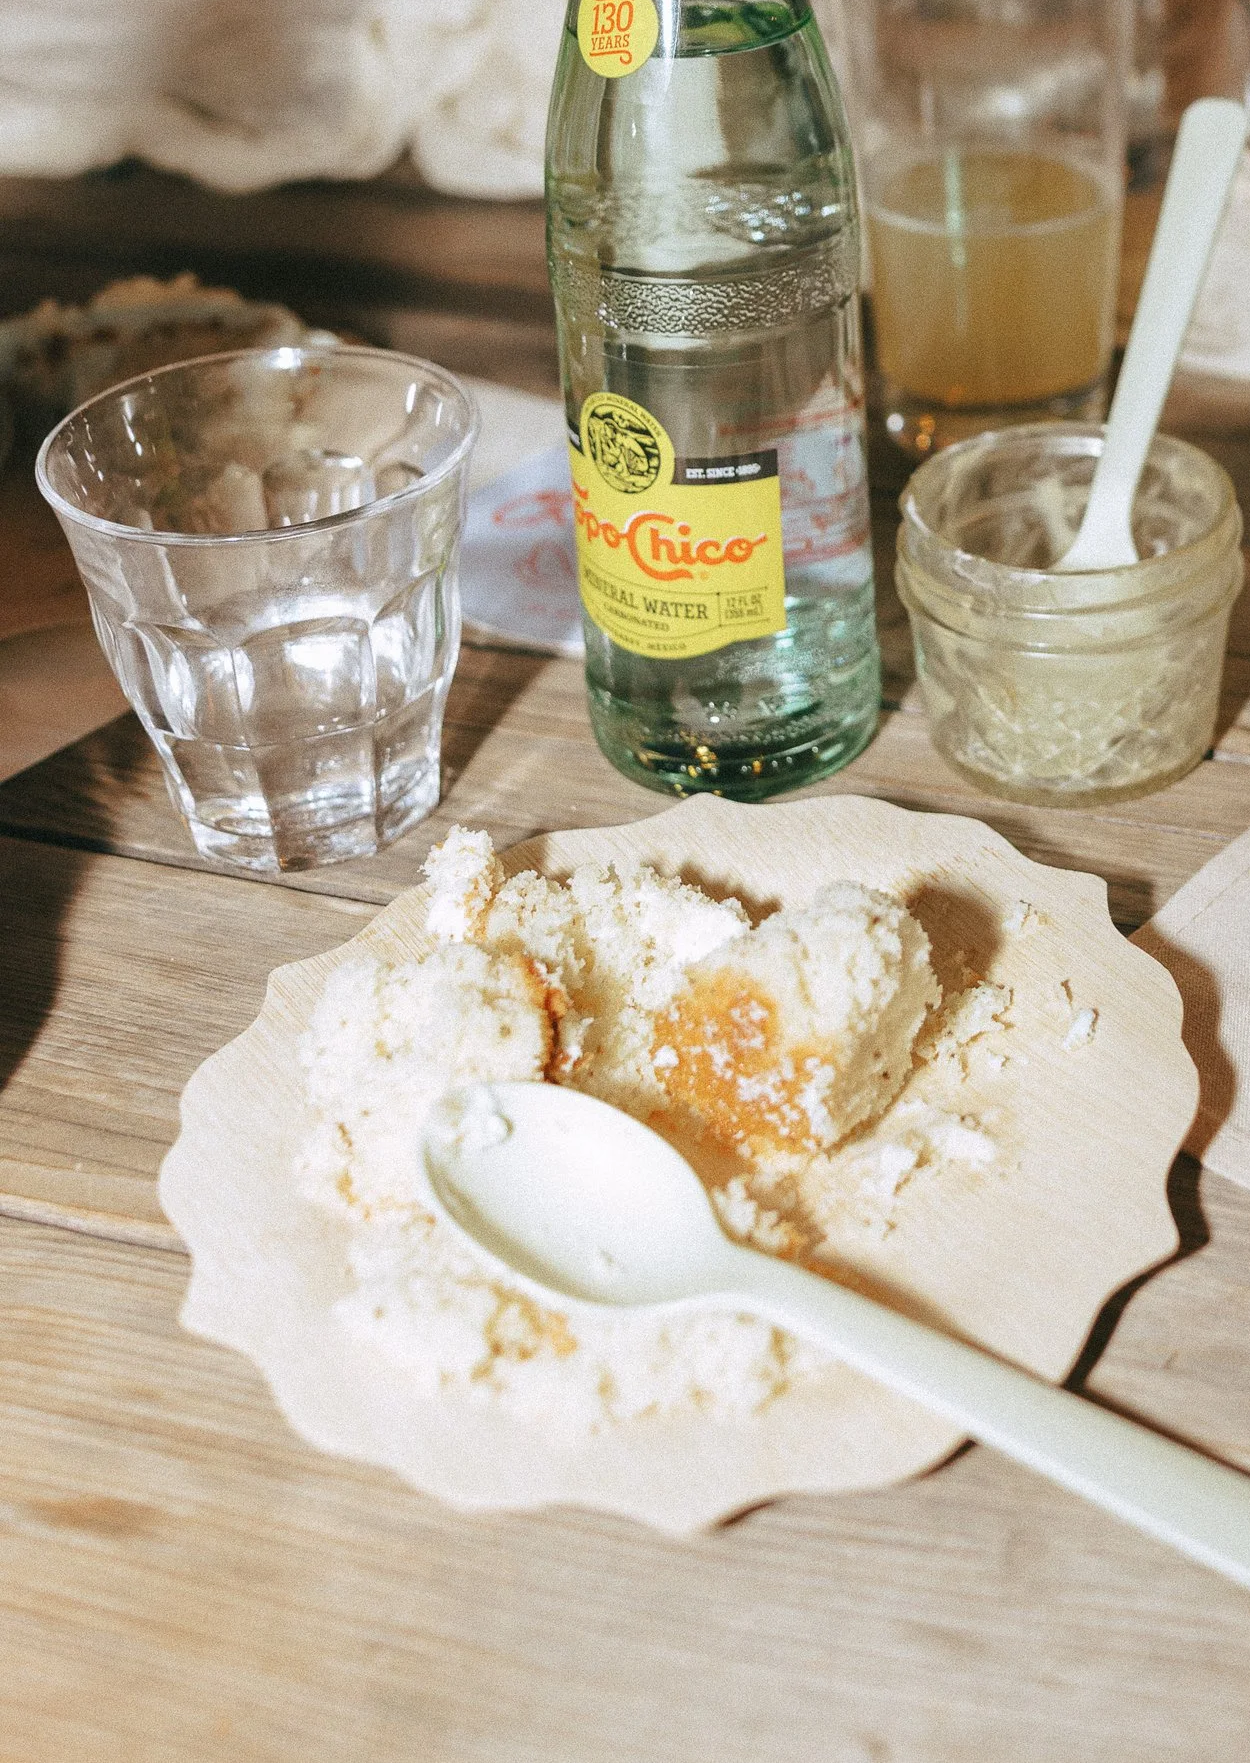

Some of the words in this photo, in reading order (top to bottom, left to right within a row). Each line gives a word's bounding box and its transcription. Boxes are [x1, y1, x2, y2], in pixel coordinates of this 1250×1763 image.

[591, 1, 634, 35] 130
[591, 34, 630, 51] YEARS
[685, 467, 706, 479] EST.
[706, 466, 735, 479] SINCE
[625, 510, 768, 581] Chico
[584, 568, 639, 610] MINERAL
[642, 596, 709, 620] WATER
[603, 602, 670, 632] CARBONATED
